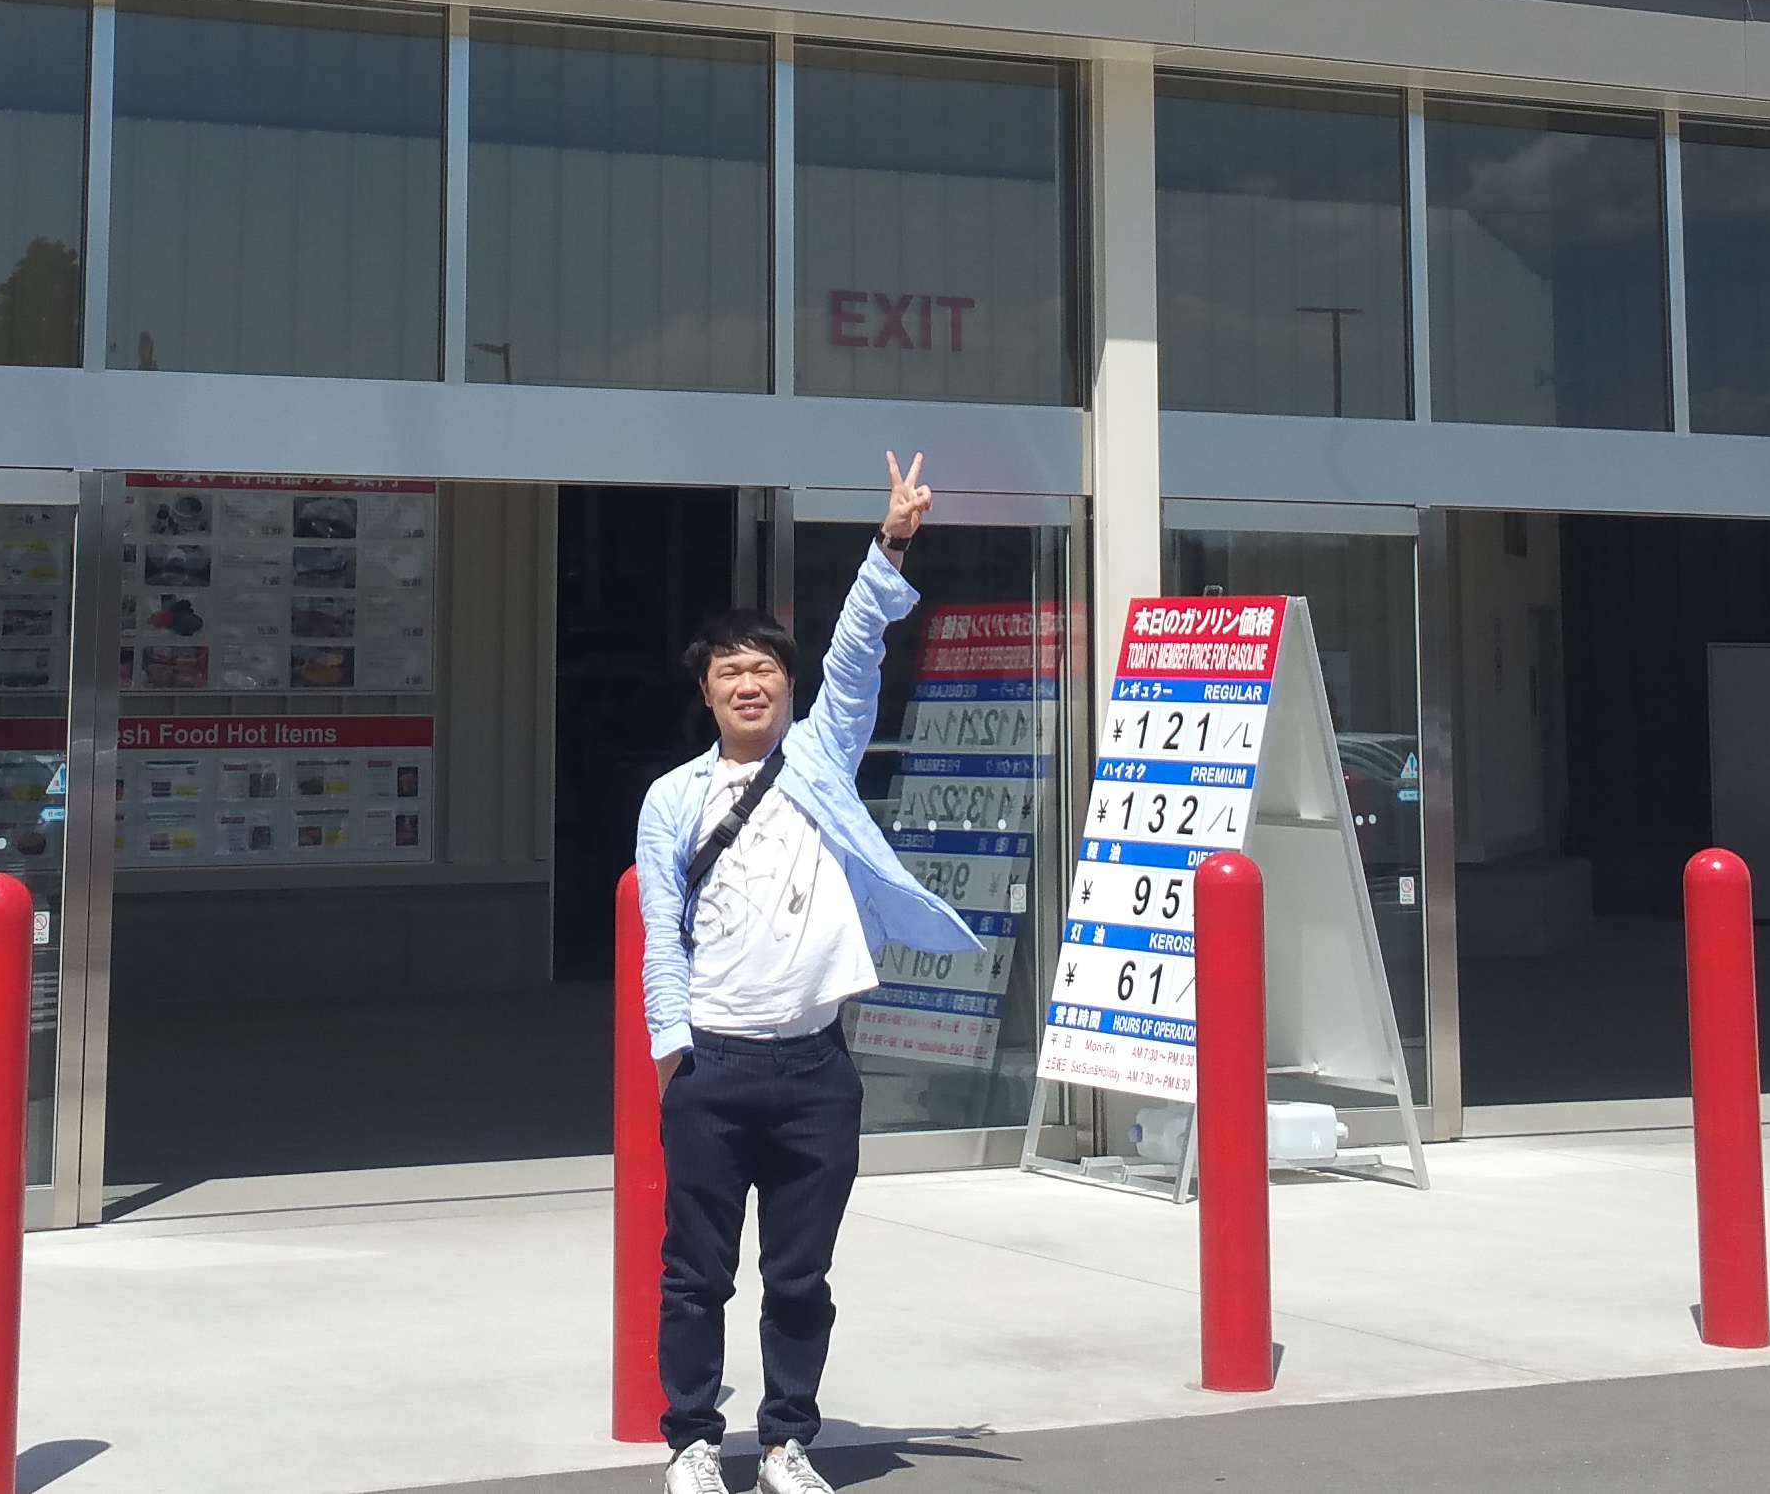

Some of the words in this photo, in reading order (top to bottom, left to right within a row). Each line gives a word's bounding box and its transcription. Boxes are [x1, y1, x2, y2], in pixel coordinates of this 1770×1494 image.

[831, 290, 975, 352] EXIT
[1132, 606, 1276, 637] 本日のガソリン価格
[1126, 642, 1160, 669] TODAY'S
[1157, 642, 1190, 669] MEMBER
[1188, 642, 1213, 670] PRICE
[1210, 643, 1230, 670] FOR
[1227, 643, 1269, 671] GASOLINE
[1118, 681, 1173, 699] レギュラー
[1203, 684, 1263, 702] REGULAR
[117, 723, 151, 745] sh
[159, 722, 219, 745] Food
[226, 723, 268, 744] Hot
[275, 723, 337, 744] Items
[1136, 709, 1211, 752] 121
[1101, 761, 1148, 779] ハイオク
[1190, 766, 1248, 785] PREMIUM
[1121, 790, 1199, 836] 132
[1086, 840, 1122, 862] 軽油
[1132, 874, 1183, 919] 95
[1069, 923, 1106, 945] 灯油
[1117, 959, 1164, 1005] 61
[1054, 1005, 1102, 1030] 営業時間
[1112, 1014, 1141, 1033] HOURS
[1141, 1018, 1154, 1035] OF
[1050, 1032, 1072, 1049] 平日
[1131, 1046, 1143, 1058] AM
[1143, 1047, 1159, 1062] 7:30
[1167, 1051, 1179, 1065] PM
[1179, 1053, 1195, 1068] 8:30
[1126, 1070, 1138, 1083] AM
[1139, 1071, 1154, 1086] 7:30
[1162, 1075, 1174, 1089] PM
